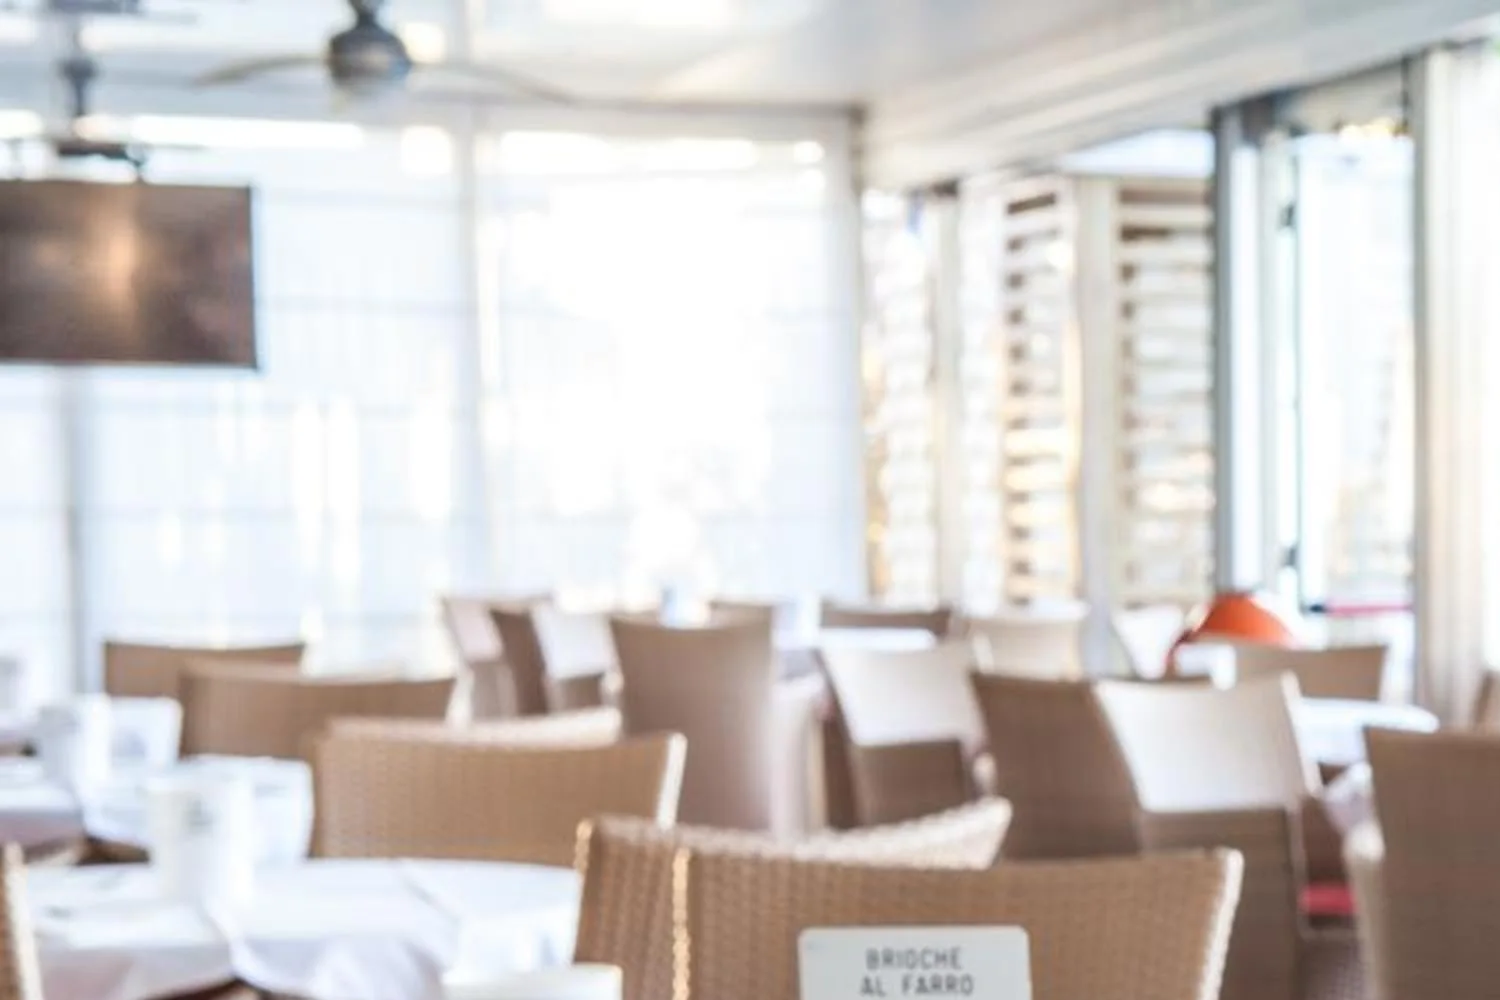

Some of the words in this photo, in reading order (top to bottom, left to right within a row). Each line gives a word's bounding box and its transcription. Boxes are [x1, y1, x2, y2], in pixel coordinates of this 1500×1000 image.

[864, 948, 963, 971] BRIOCHE
[859, 975, 888, 998] AL
[901, 973, 975, 997] FARRO
